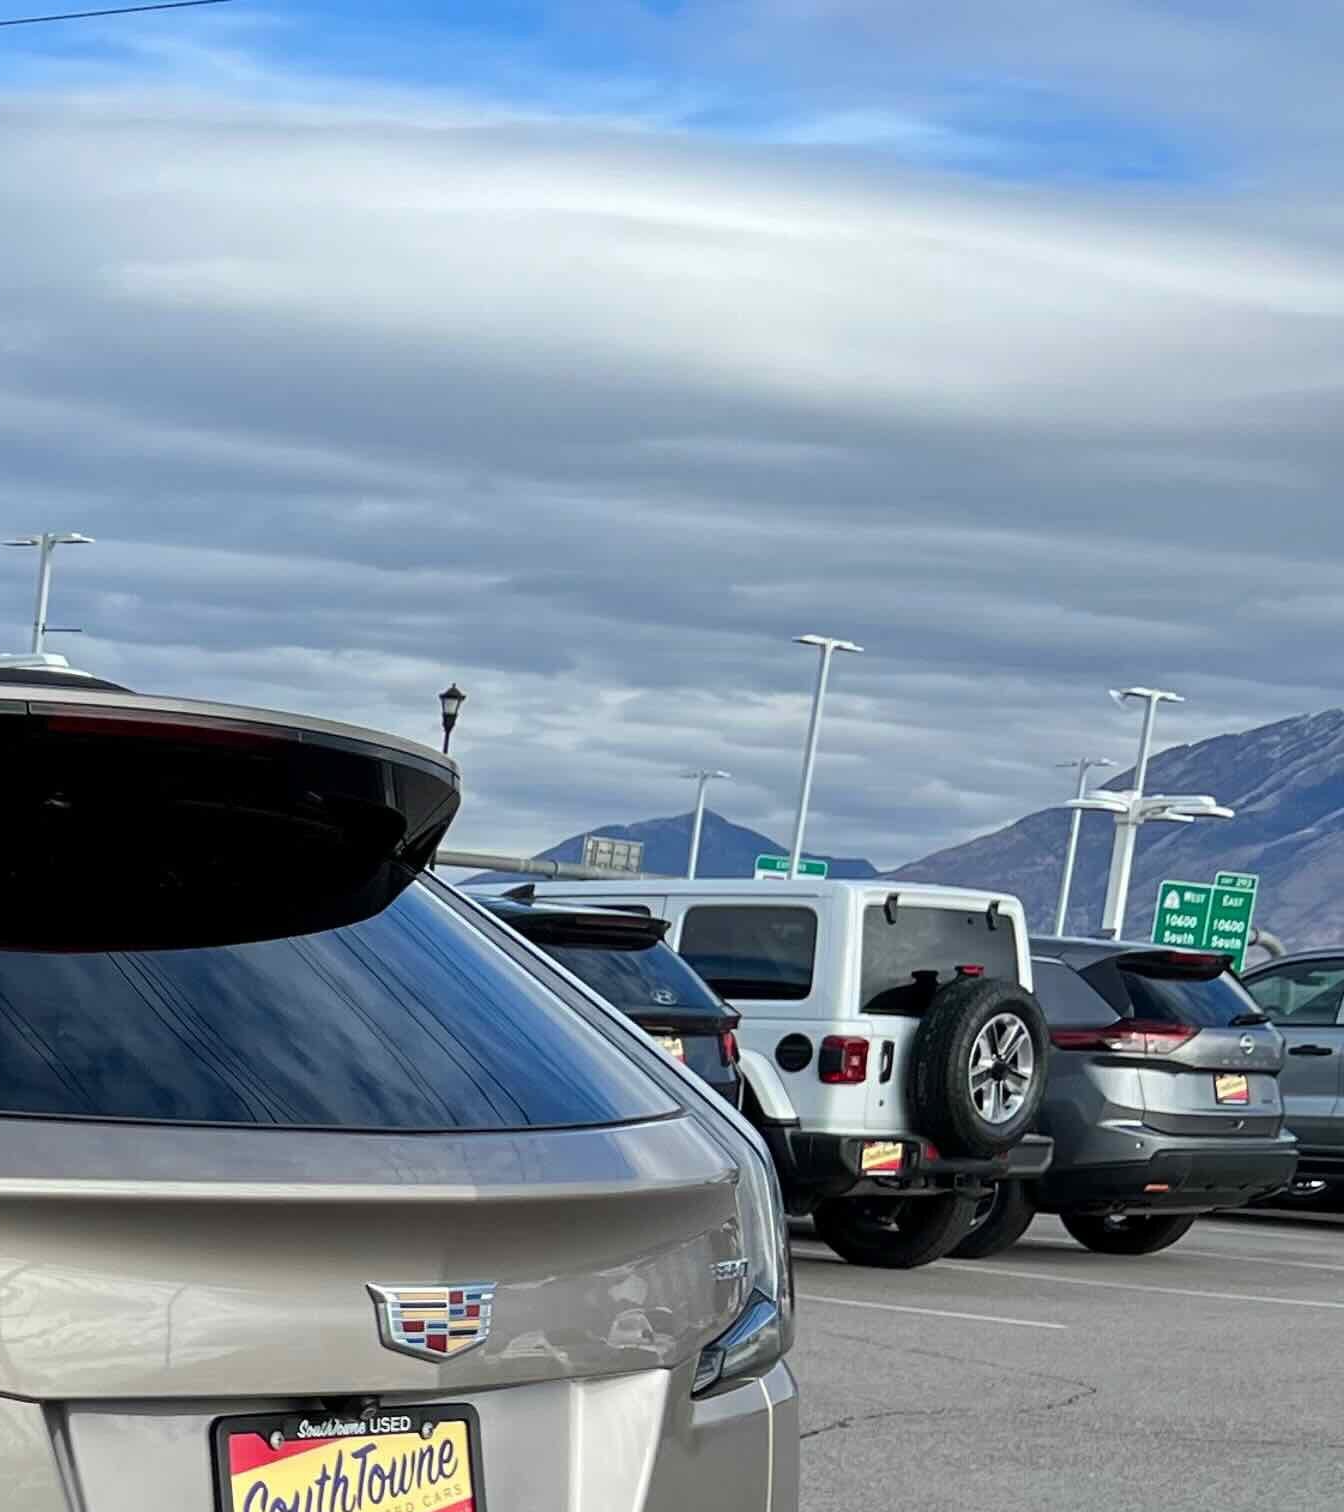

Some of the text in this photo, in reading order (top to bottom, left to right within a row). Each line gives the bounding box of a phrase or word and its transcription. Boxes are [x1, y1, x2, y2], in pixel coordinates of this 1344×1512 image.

[1183, 891, 1207, 904] WEST
[1222, 894, 1245, 907] EAST
[1165, 914, 1198, 929] 10600
[1213, 919, 1245, 934] 10600
[1163, 930, 1195, 945] South
[1211, 935, 1243, 950] South
[369, 1415, 411, 1433] USED
[422, 1484, 463, 1507] CARS
